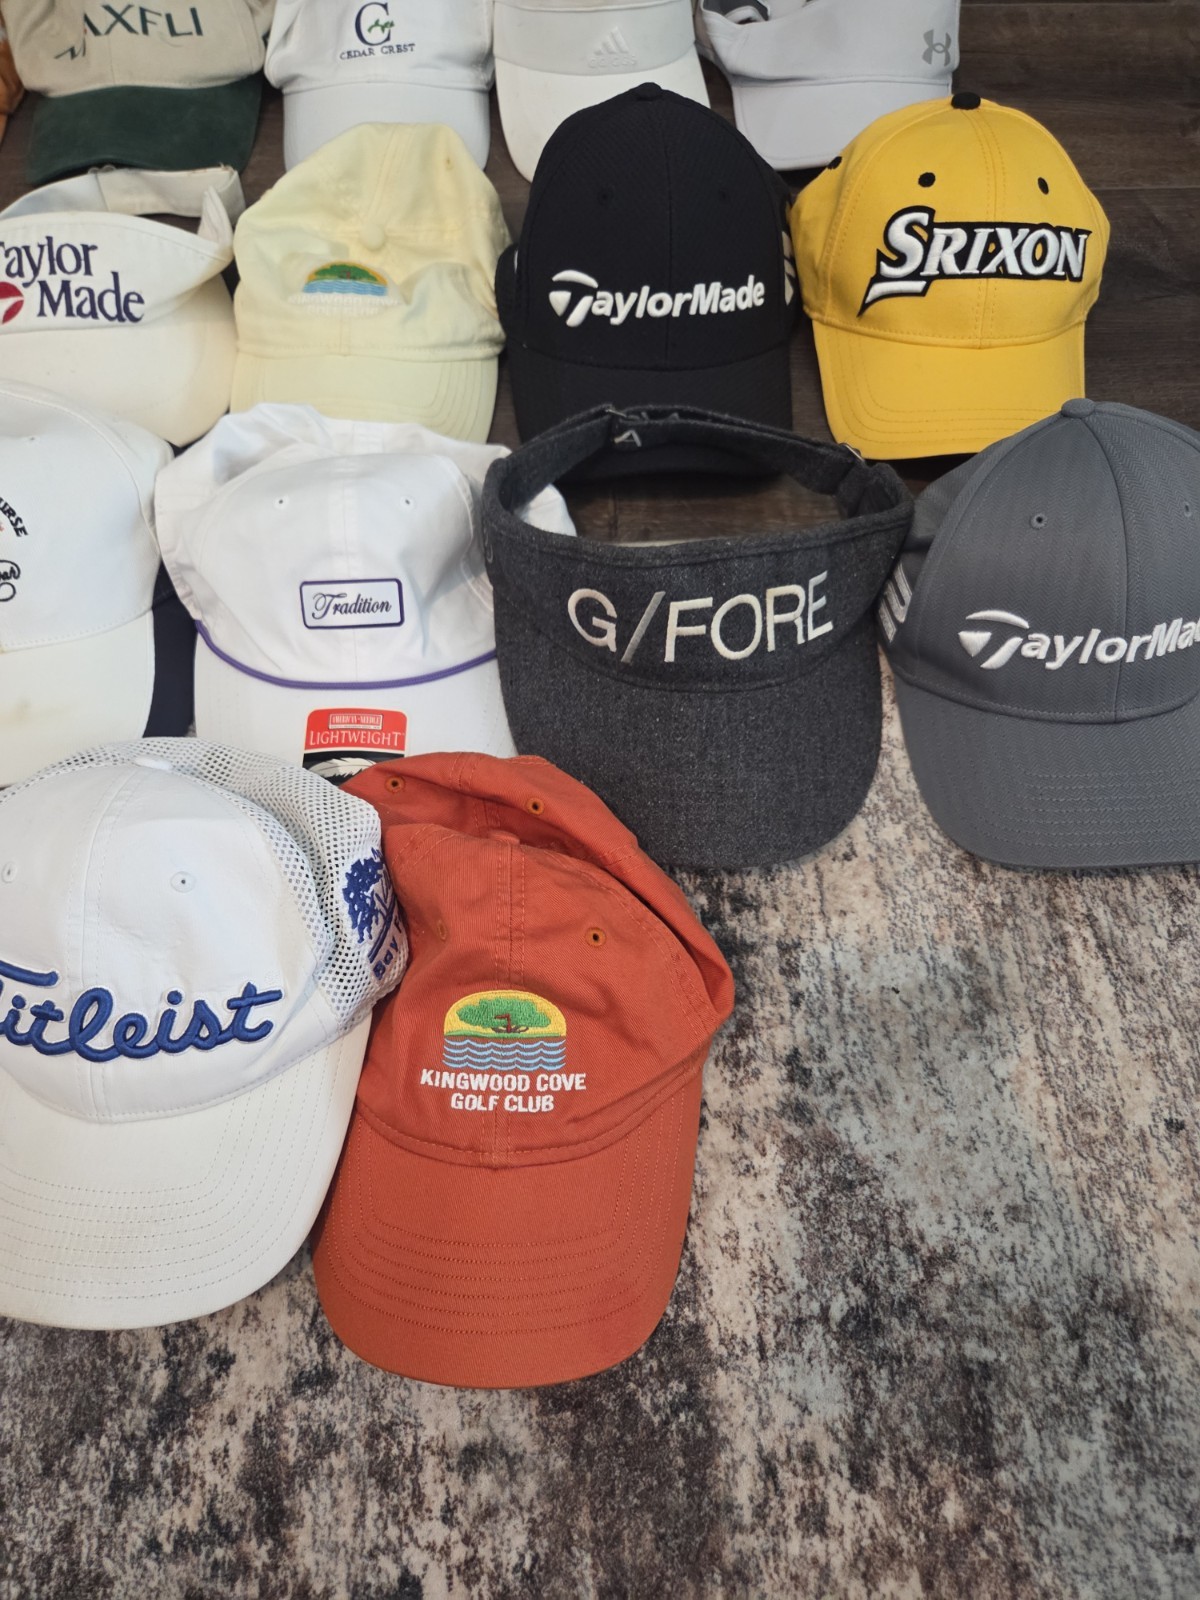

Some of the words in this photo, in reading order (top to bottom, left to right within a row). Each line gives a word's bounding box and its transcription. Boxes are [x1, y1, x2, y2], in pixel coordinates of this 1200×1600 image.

[340, 48, 375, 60] CEDAR
[380, 43, 416, 55] CREST
[876, 205, 1092, 282] SRIXON
[37, 271, 146, 323] Made
[549, 270, 765, 327] TaylorMade
[312, 592, 392, 620] Tradition
[567, 570, 834, 663] G/FORE
[309, 730, 401, 747] LIGHTWEIGHT
[420, 1069, 530, 1091] KINGWOOD
[536, 1073, 586, 1091] COVE
[451, 1093, 499, 1112] GOLF
[504, 1094, 554, 1112] CLUB
